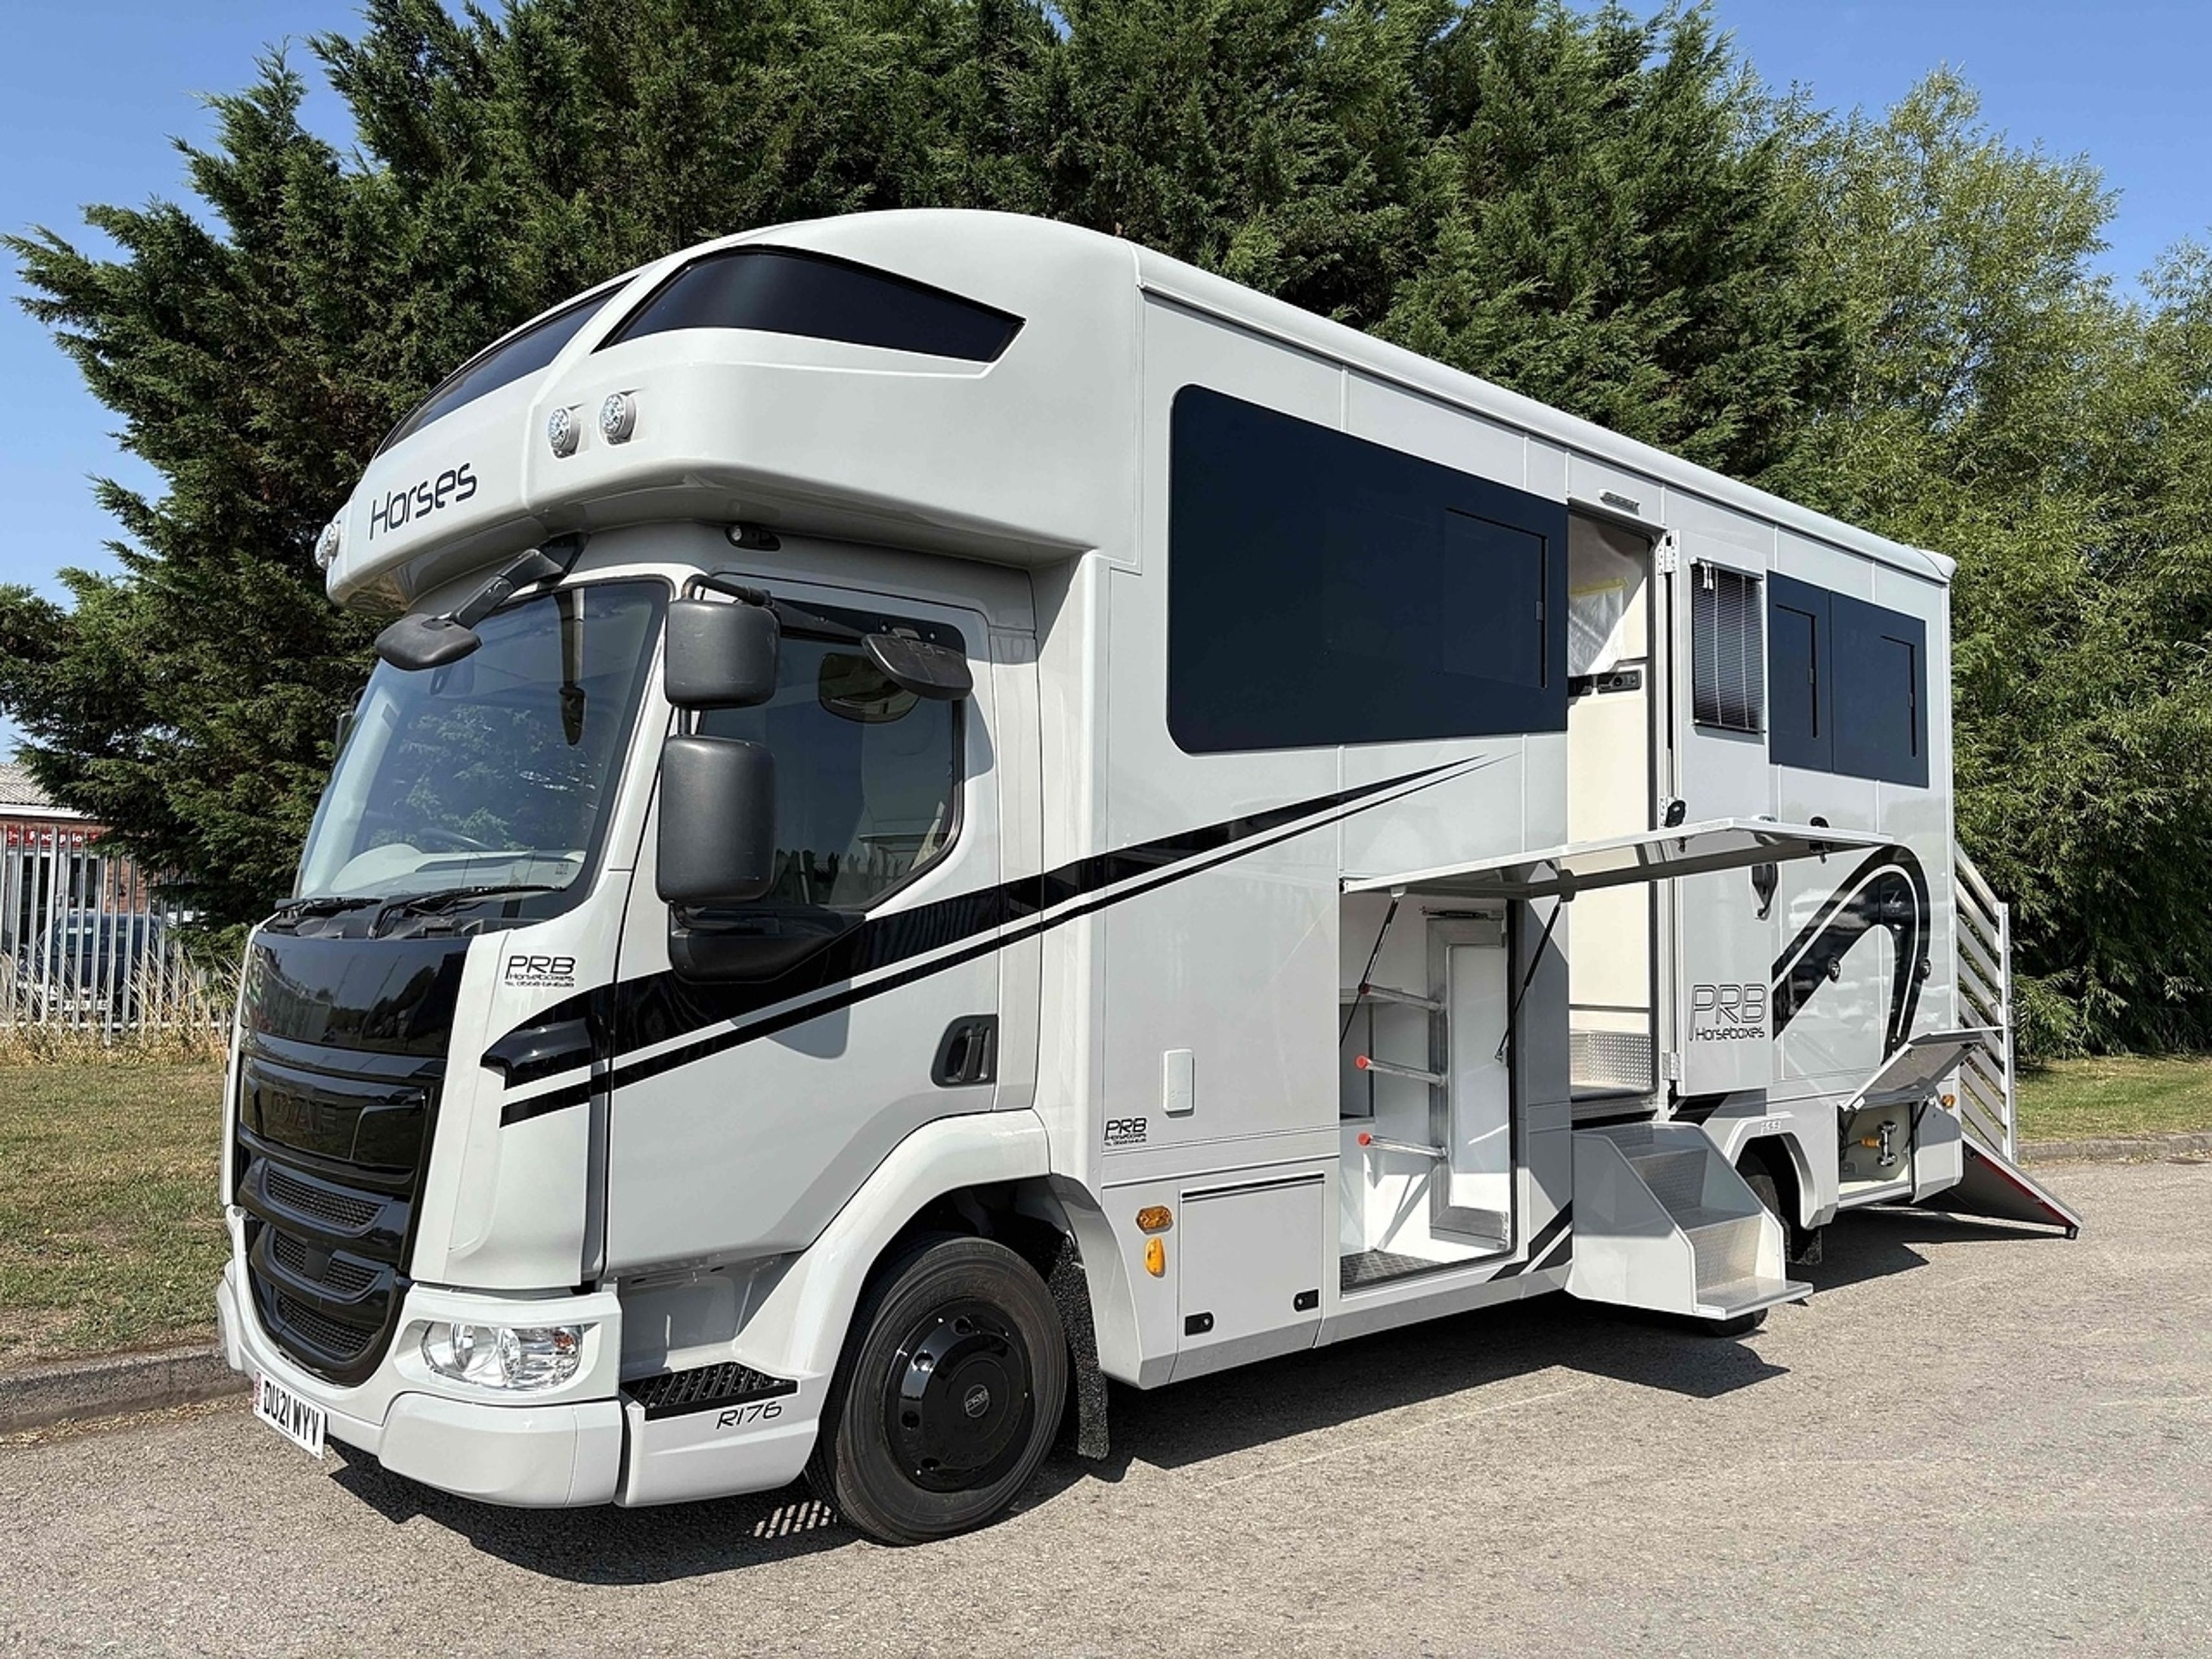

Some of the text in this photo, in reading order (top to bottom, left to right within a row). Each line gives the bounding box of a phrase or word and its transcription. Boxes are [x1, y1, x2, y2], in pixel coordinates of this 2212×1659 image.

[369, 463, 478, 540] Horses
[505, 955, 576, 979] PRB
[1688, 984, 1768, 1041] PRB
[1695, 1026, 1765, 1041] Horseboxes
[1104, 1118, 1147, 1141] PRB
[264, 1380, 291, 1429] DU21
[716, 1401, 782, 1430] R176
